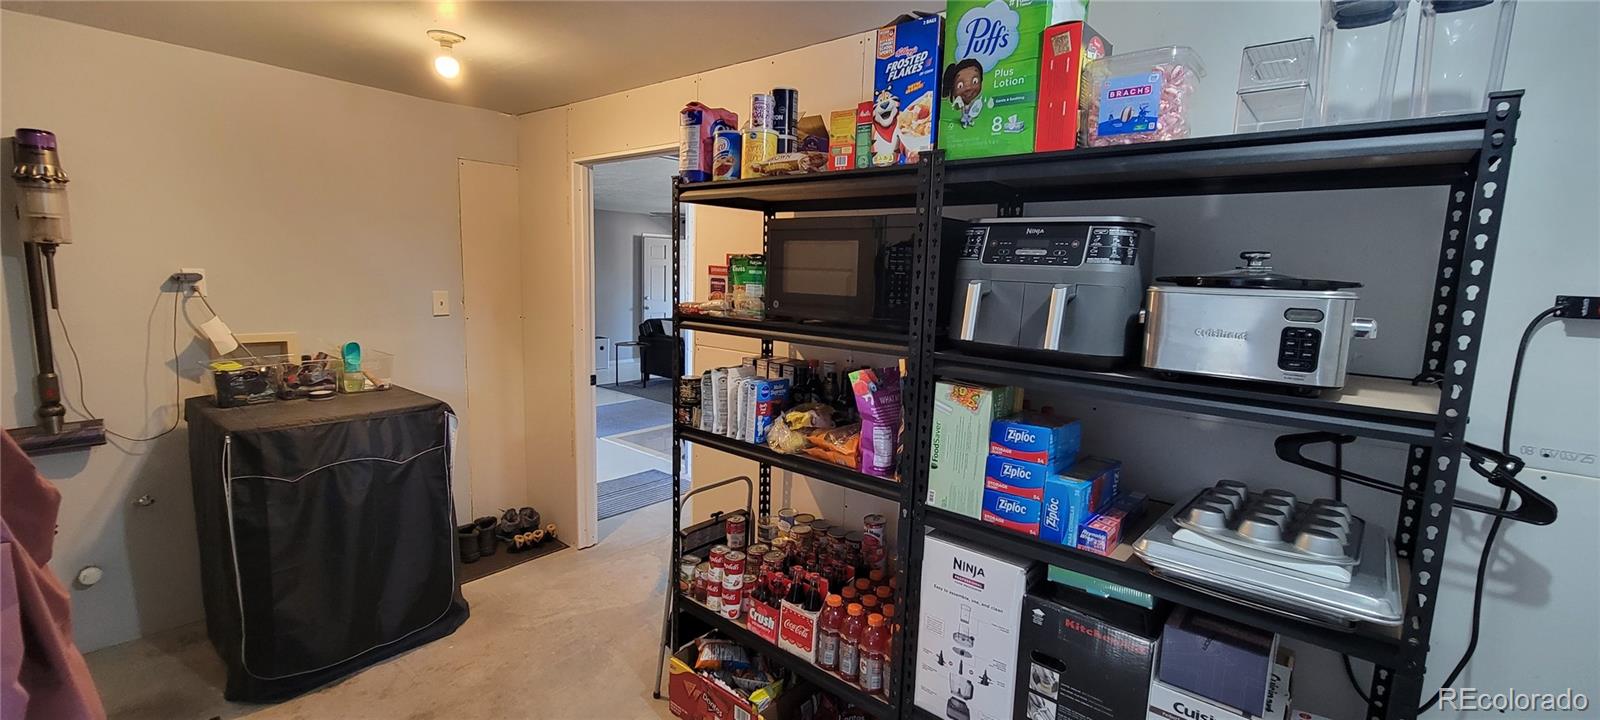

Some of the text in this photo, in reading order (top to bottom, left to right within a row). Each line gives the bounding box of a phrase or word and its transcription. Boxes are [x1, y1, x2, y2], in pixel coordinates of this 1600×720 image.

[963, 17, 1010, 59] Puffs
[885, 50, 929, 74] FROSTED
[888, 61, 924, 82] FLAKES
[995, 68, 1014, 78] Plus
[993, 77, 1025, 89] Lotion
[992, 116, 1002, 132] 8
[1026, 227, 1045, 236] NINJA
[932, 420, 943, 463] FoodSaver
[1008, 429, 1036, 443] Ziploc
[1003, 464, 1032, 480] Ziploc
[999, 499, 1027, 515] Ziploc
[1046, 497, 1059, 528] Ziploc
[953, 556, 985, 578] NINJA
[750, 608, 775, 630] Crush
